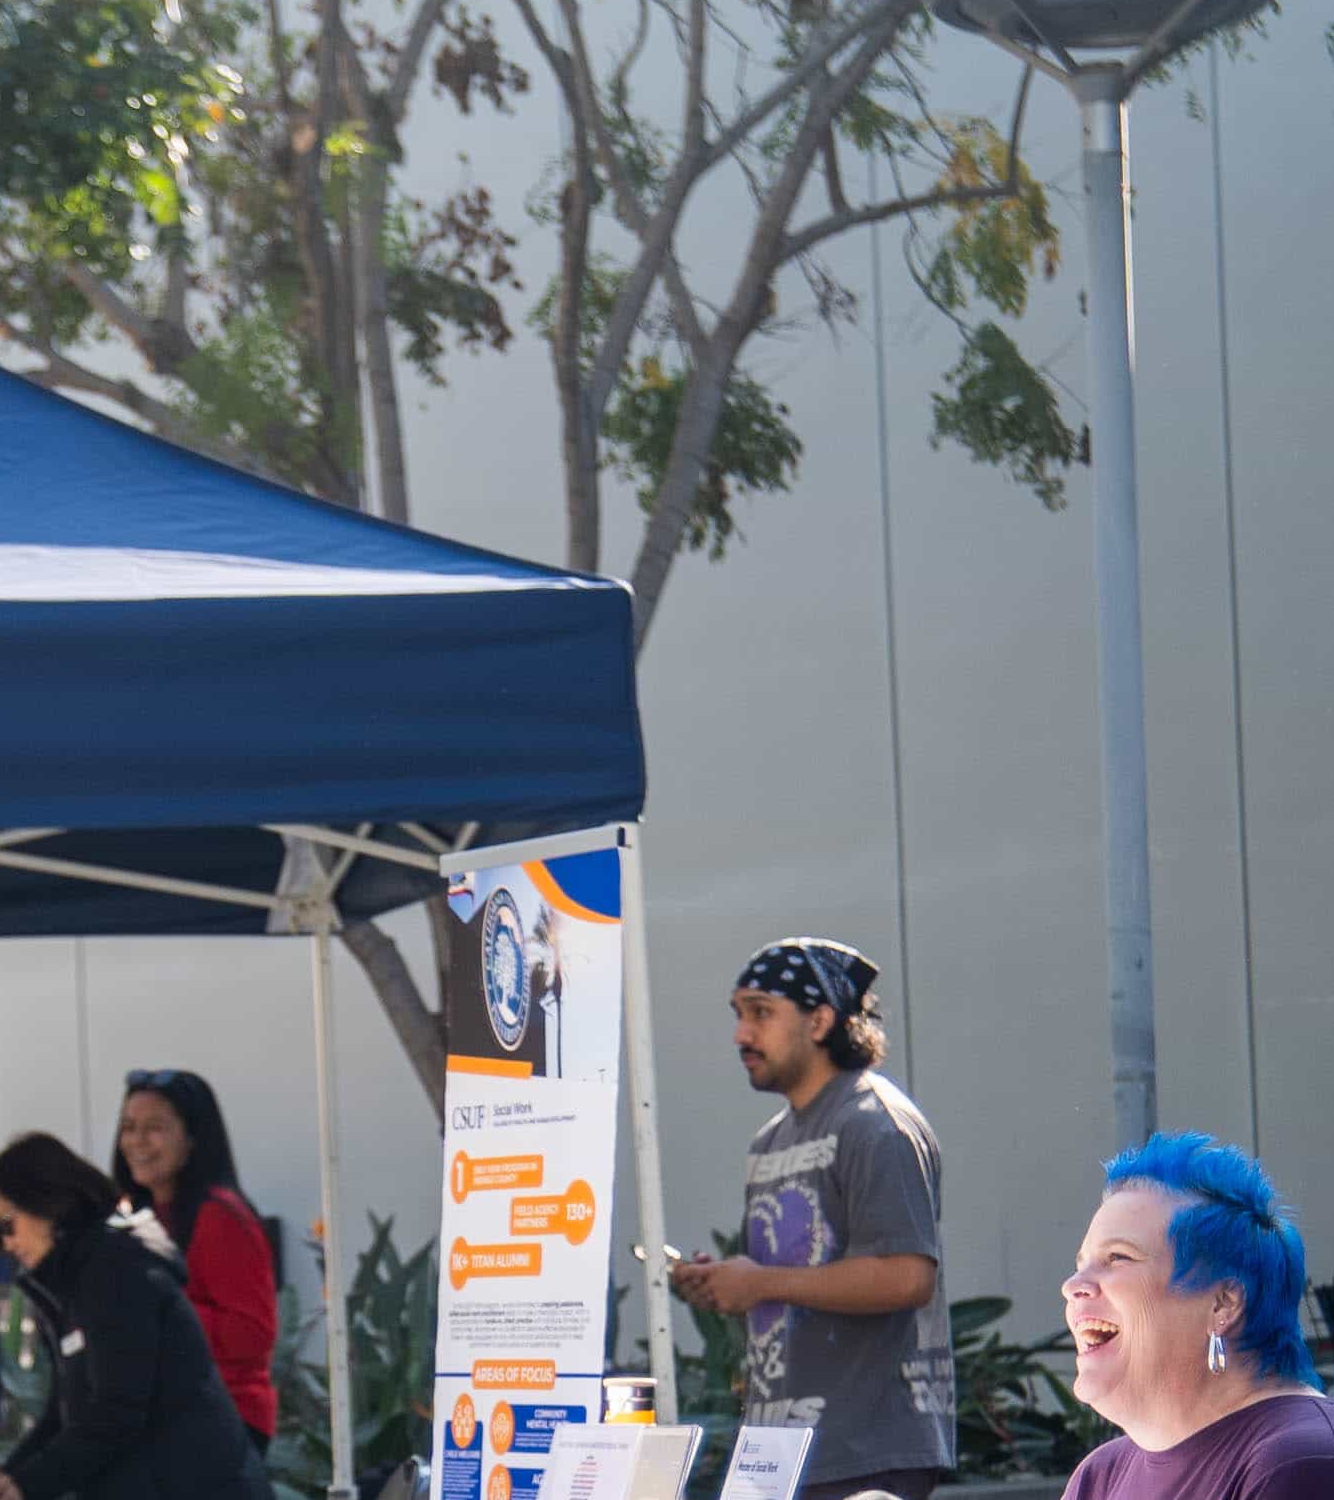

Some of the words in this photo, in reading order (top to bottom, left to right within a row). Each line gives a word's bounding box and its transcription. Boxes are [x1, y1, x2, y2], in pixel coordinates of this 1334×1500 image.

[452, 1105, 484, 1130] CSUF
[493, 1103, 512, 1116] Social
[514, 1102, 532, 1114] Work
[566, 1203, 593, 1221] 130+
[471, 1254, 495, 1269] TITAN
[496, 1252, 530, 1268] ALUMNI
[474, 1367, 504, 1382] AREAS
[505, 1367, 519, 1382] OF
[521, 1367, 553, 1383] FOCUS
